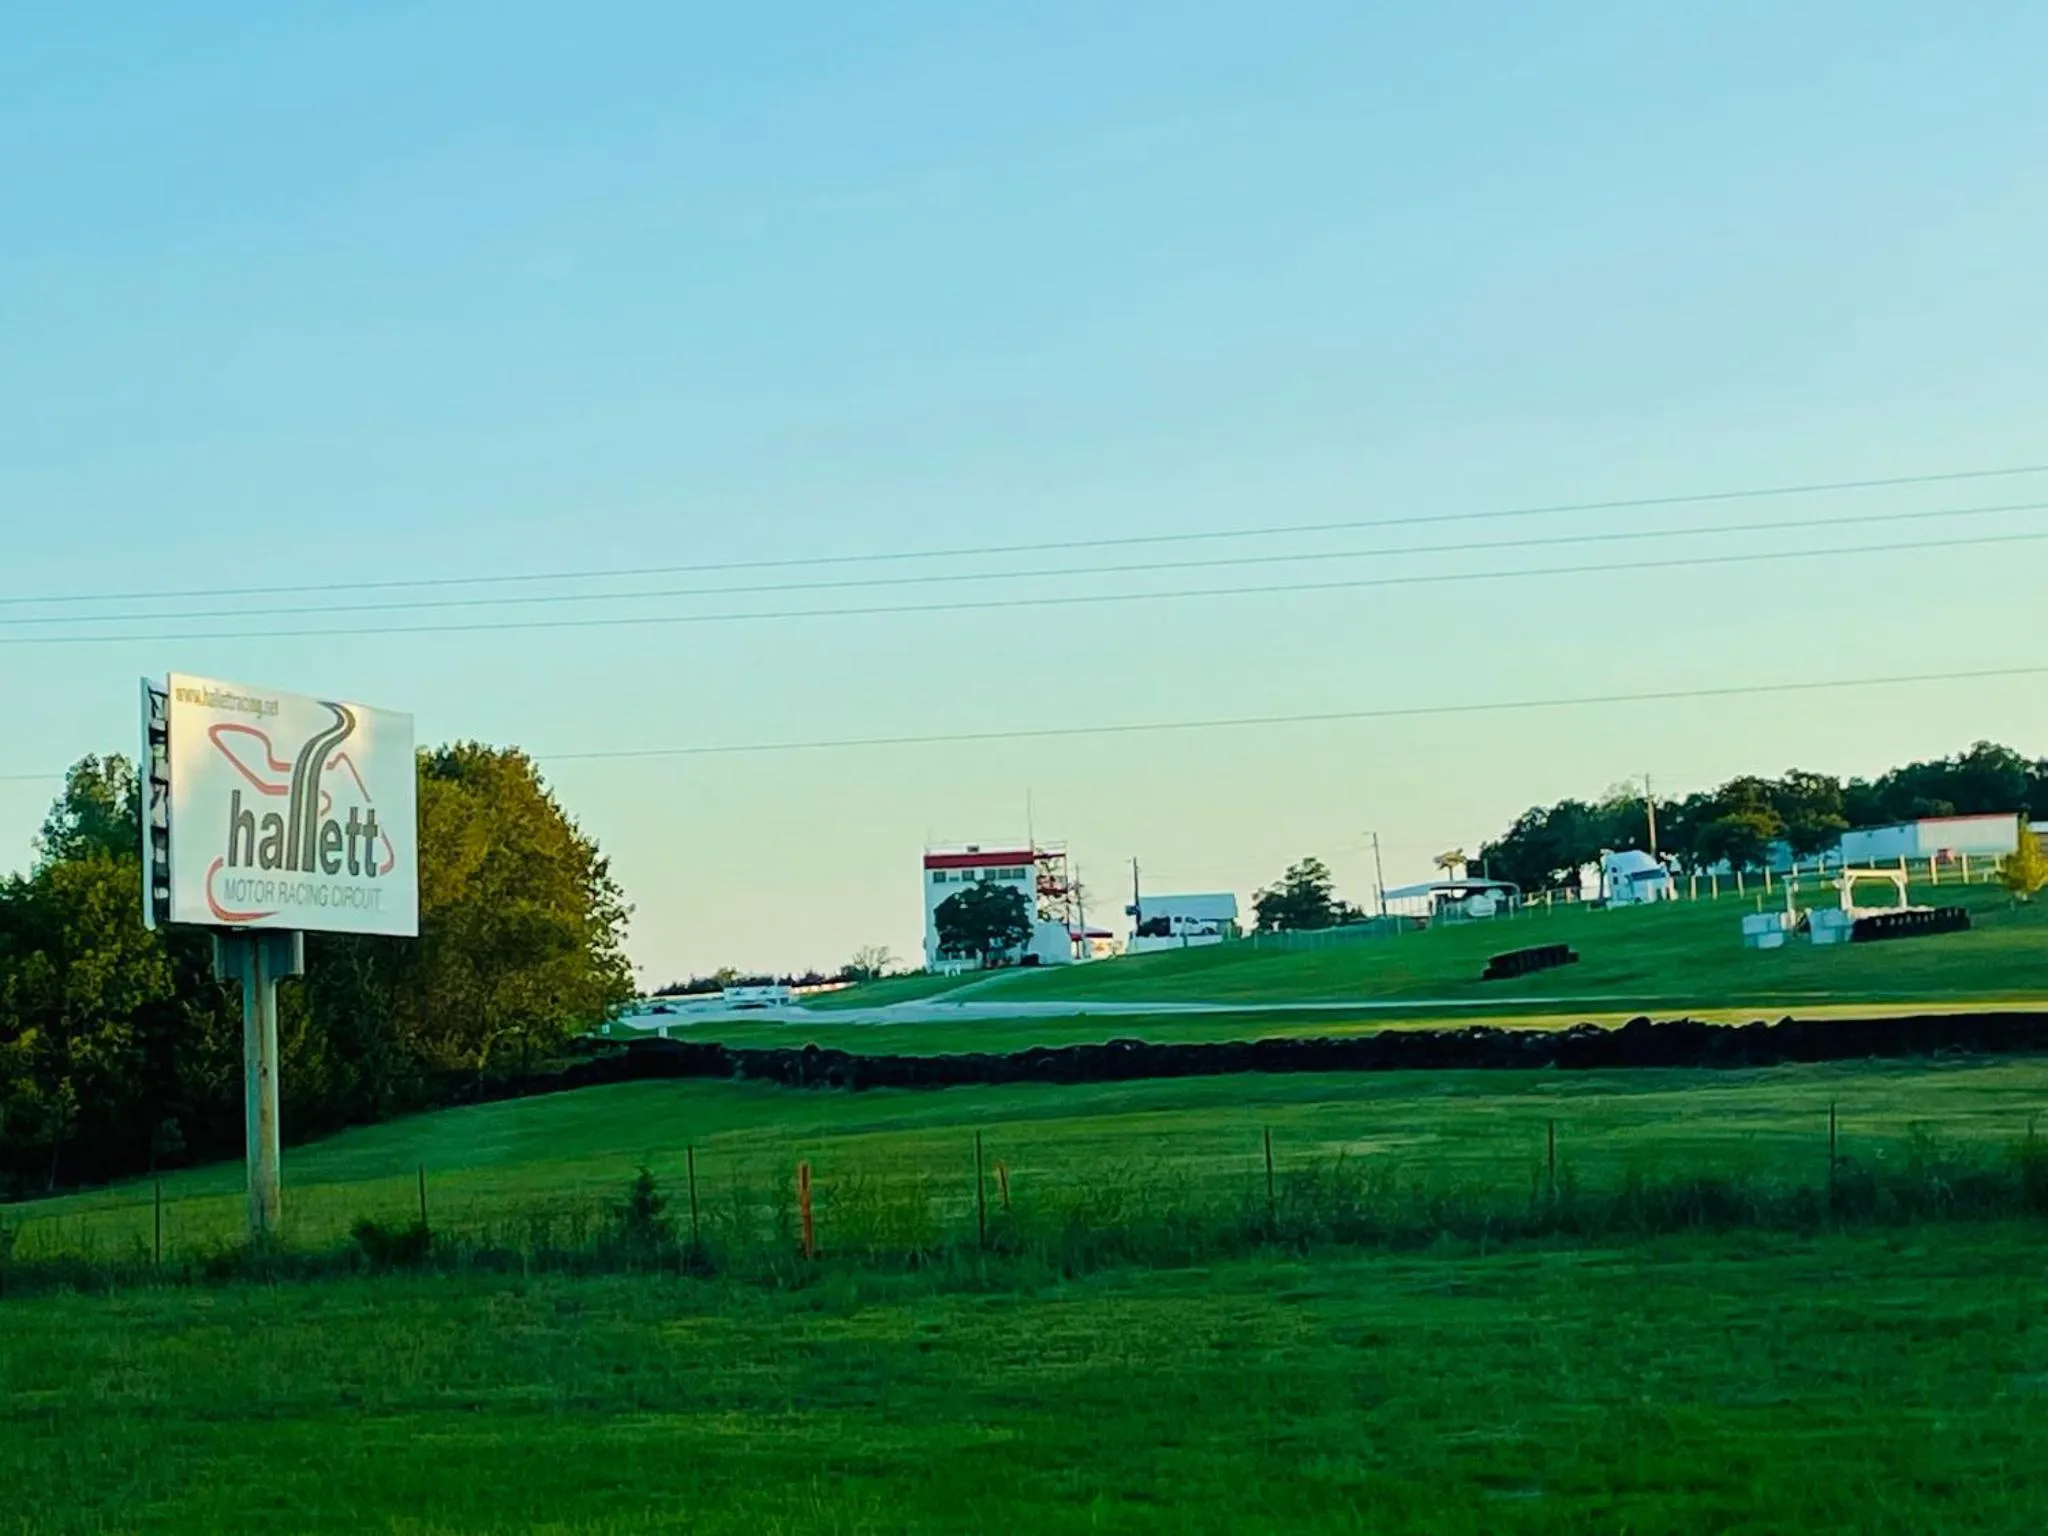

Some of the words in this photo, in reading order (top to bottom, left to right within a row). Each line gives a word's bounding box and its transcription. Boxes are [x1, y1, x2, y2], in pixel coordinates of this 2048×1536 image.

[228, 761, 378, 878] hallett
[224, 878, 274, 904] MOTOR
[279, 880, 328, 906] RACING
[332, 885, 383, 910] CIRCUIT
